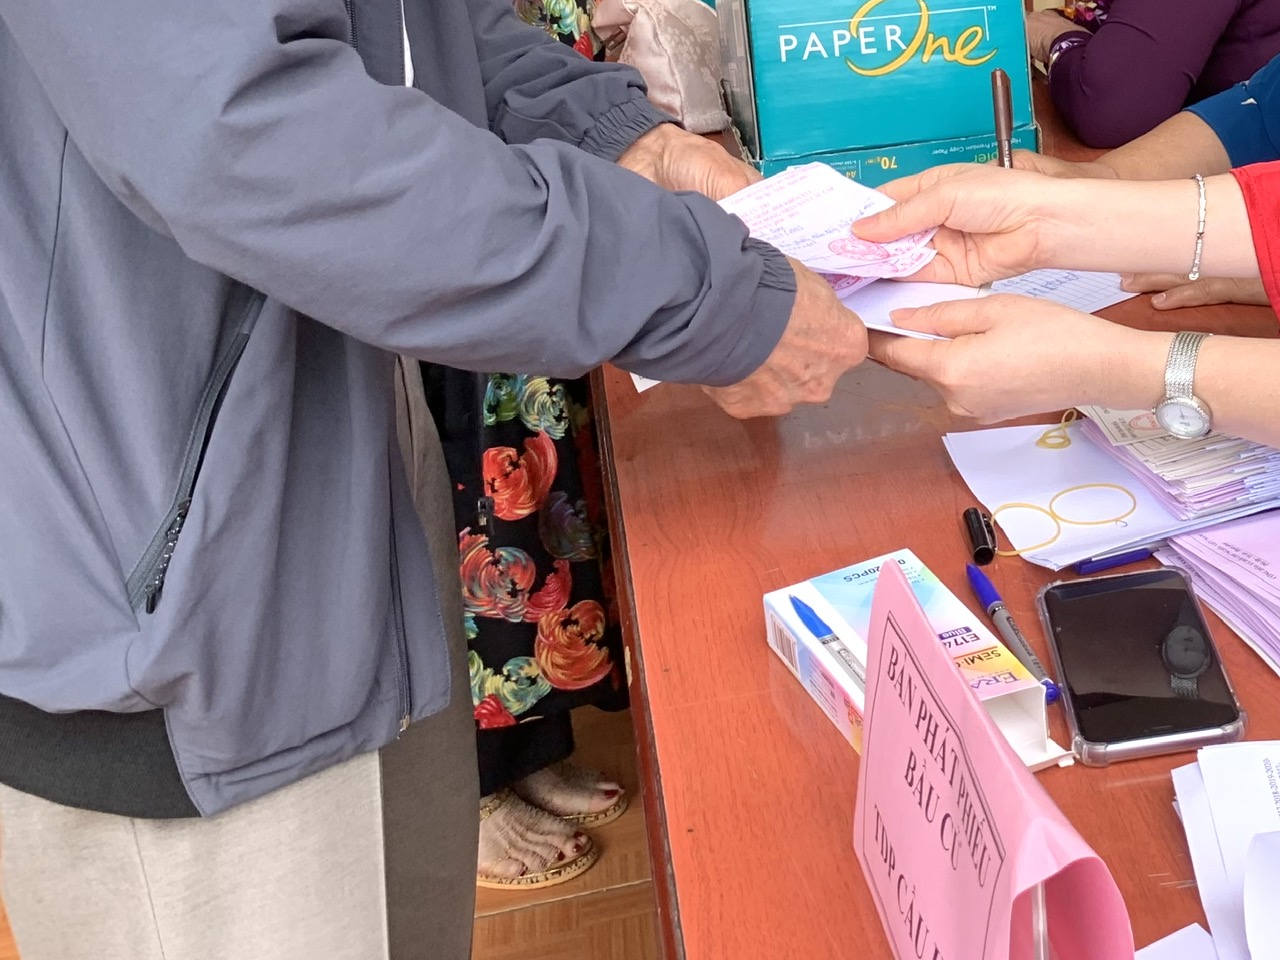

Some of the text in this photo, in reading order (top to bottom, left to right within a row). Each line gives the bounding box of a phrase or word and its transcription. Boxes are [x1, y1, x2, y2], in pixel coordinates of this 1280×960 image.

[779, 24, 907, 62] PAPER
[941, 628, 966, 640] Blue
[954, 649, 1001, 668] SEMI-
[915, 696, 960, 787] PHÁT
[957, 772, 991, 888] PHIẾU
